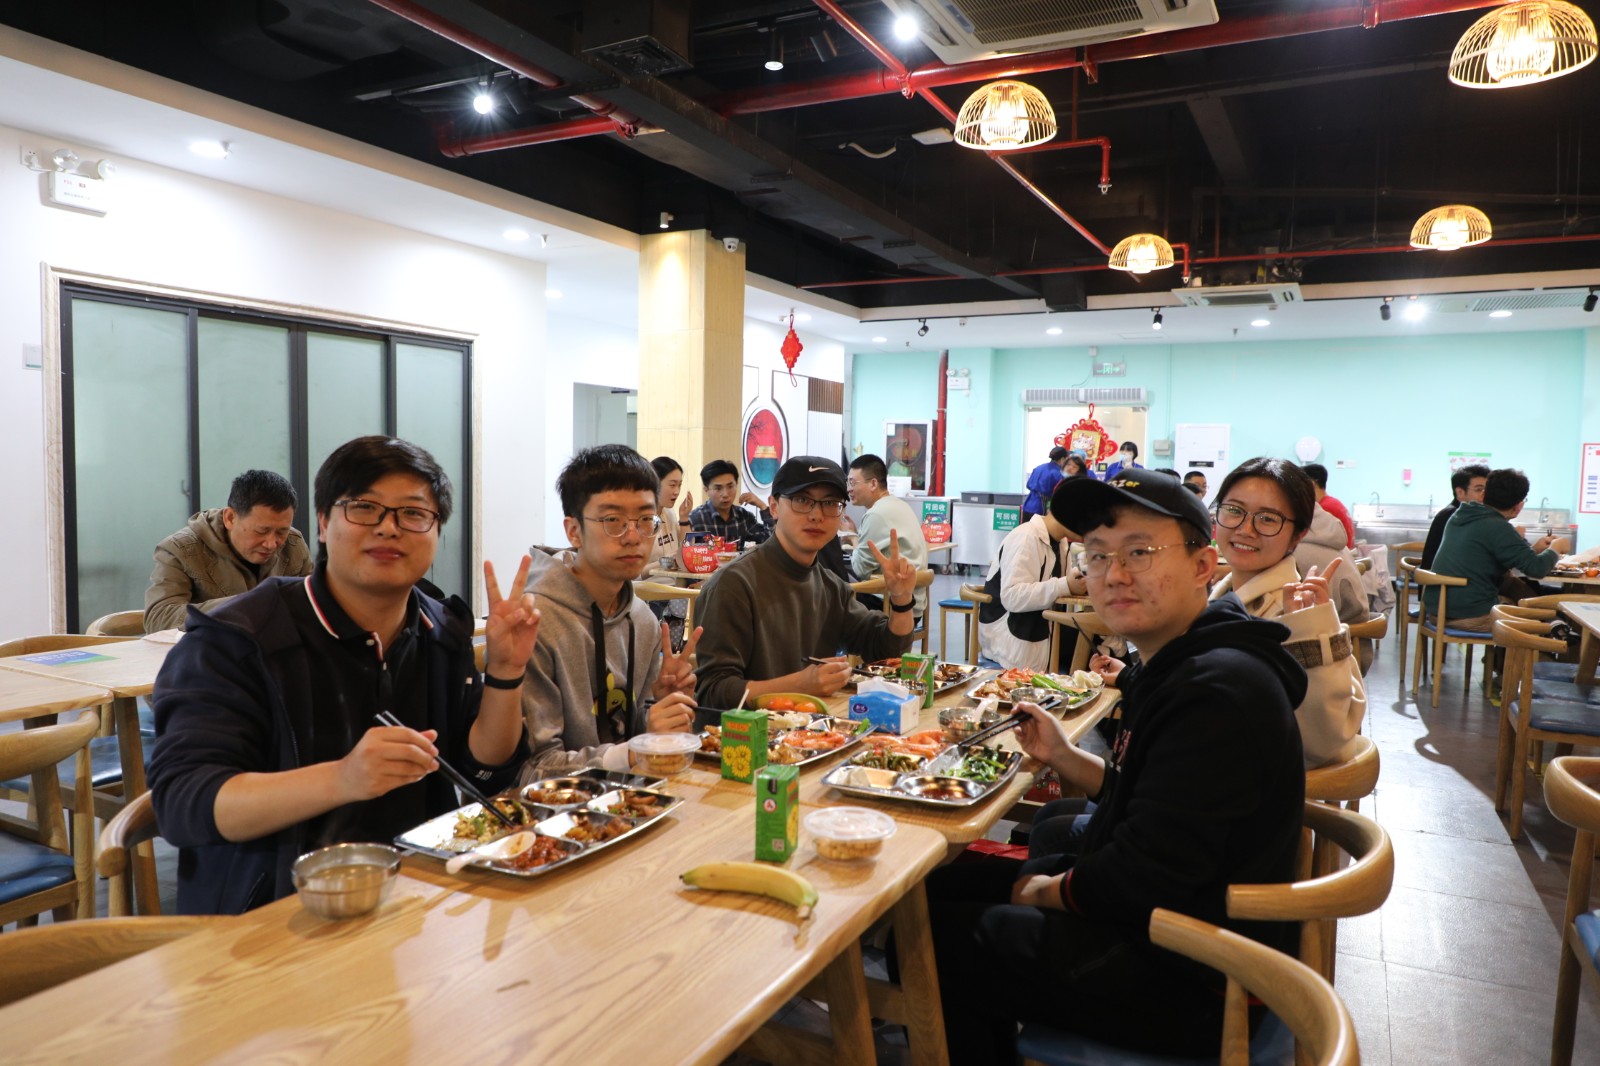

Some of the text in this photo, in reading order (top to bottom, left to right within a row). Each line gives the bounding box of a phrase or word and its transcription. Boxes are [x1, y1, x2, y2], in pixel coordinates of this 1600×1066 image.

[925, 503, 946, 512] 可回收
[996, 512, 1018, 521] 可回收
